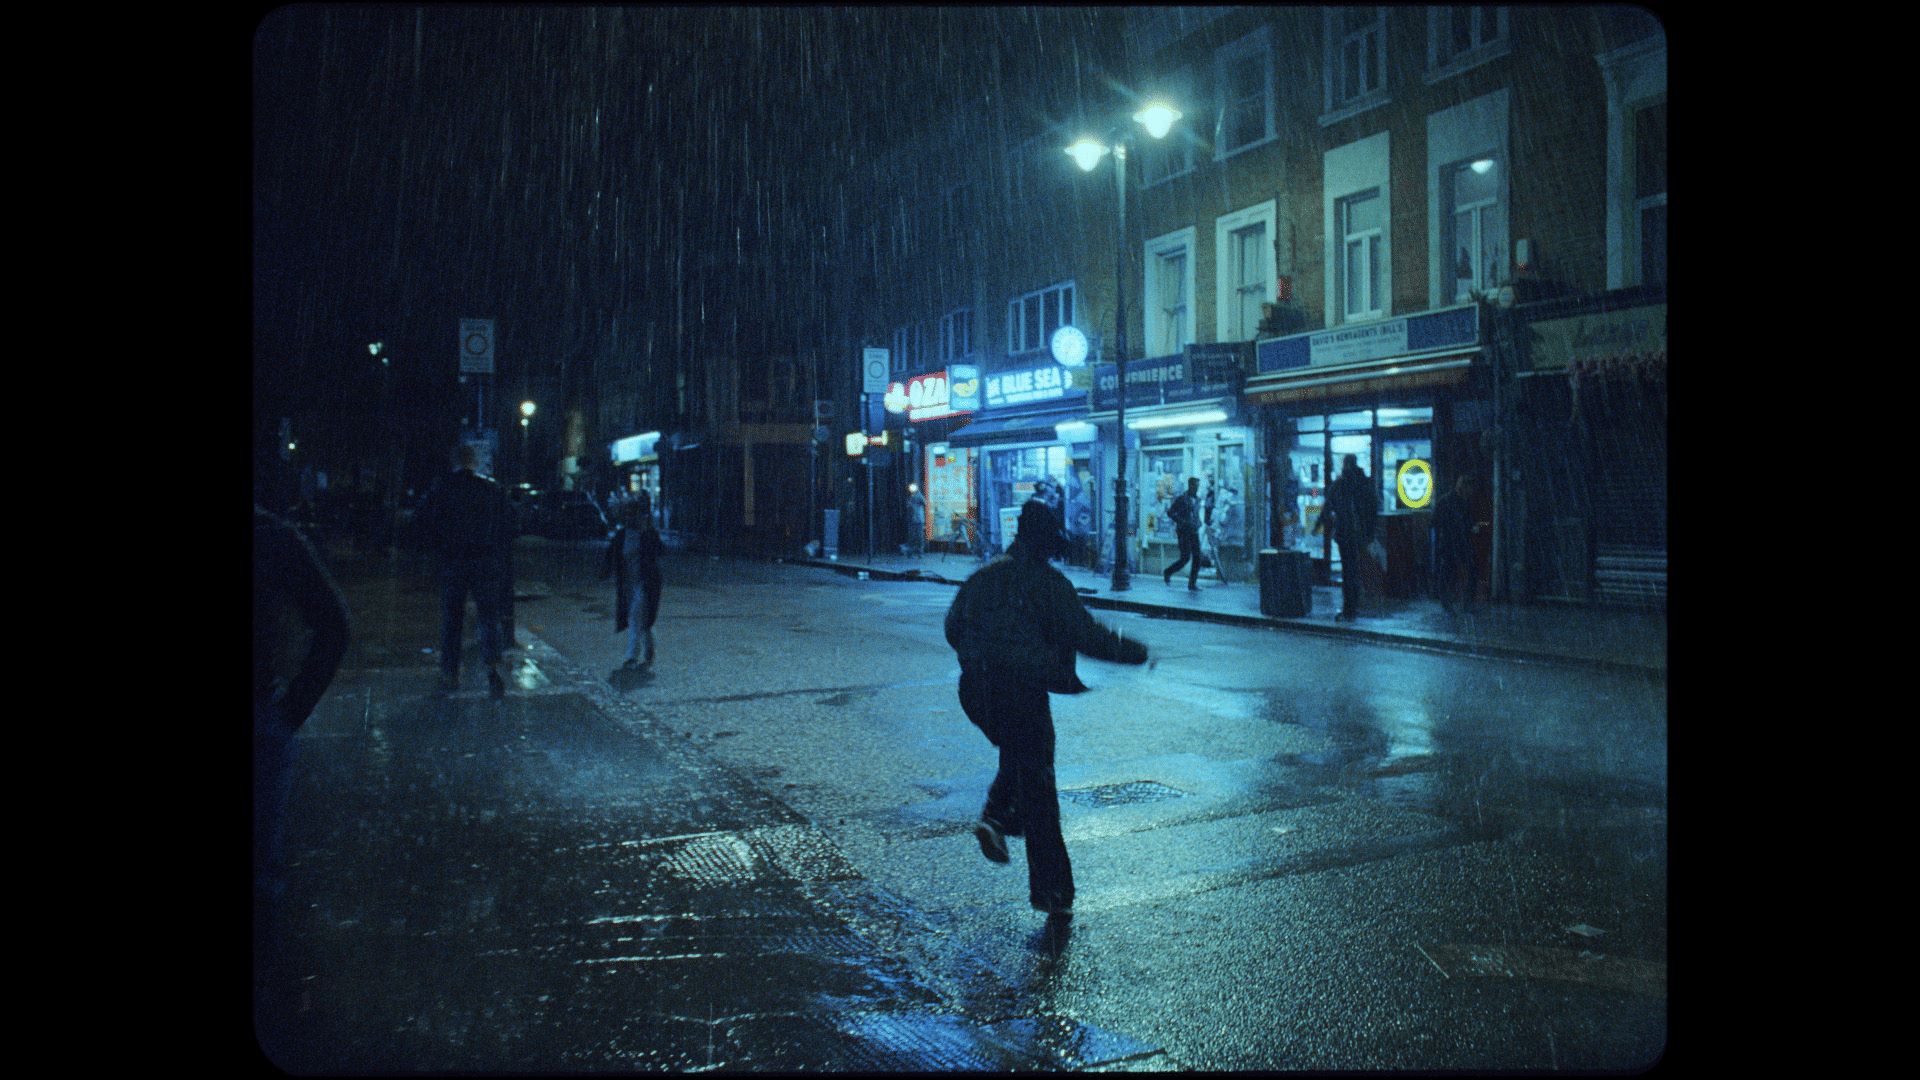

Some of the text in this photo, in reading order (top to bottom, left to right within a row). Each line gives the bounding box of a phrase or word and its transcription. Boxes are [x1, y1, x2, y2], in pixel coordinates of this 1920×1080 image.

[1336, 327, 1377, 342] NEWSAGENTS
[1002, 371, 1033, 394] BLUE
[1034, 366, 1061, 389] SEA
